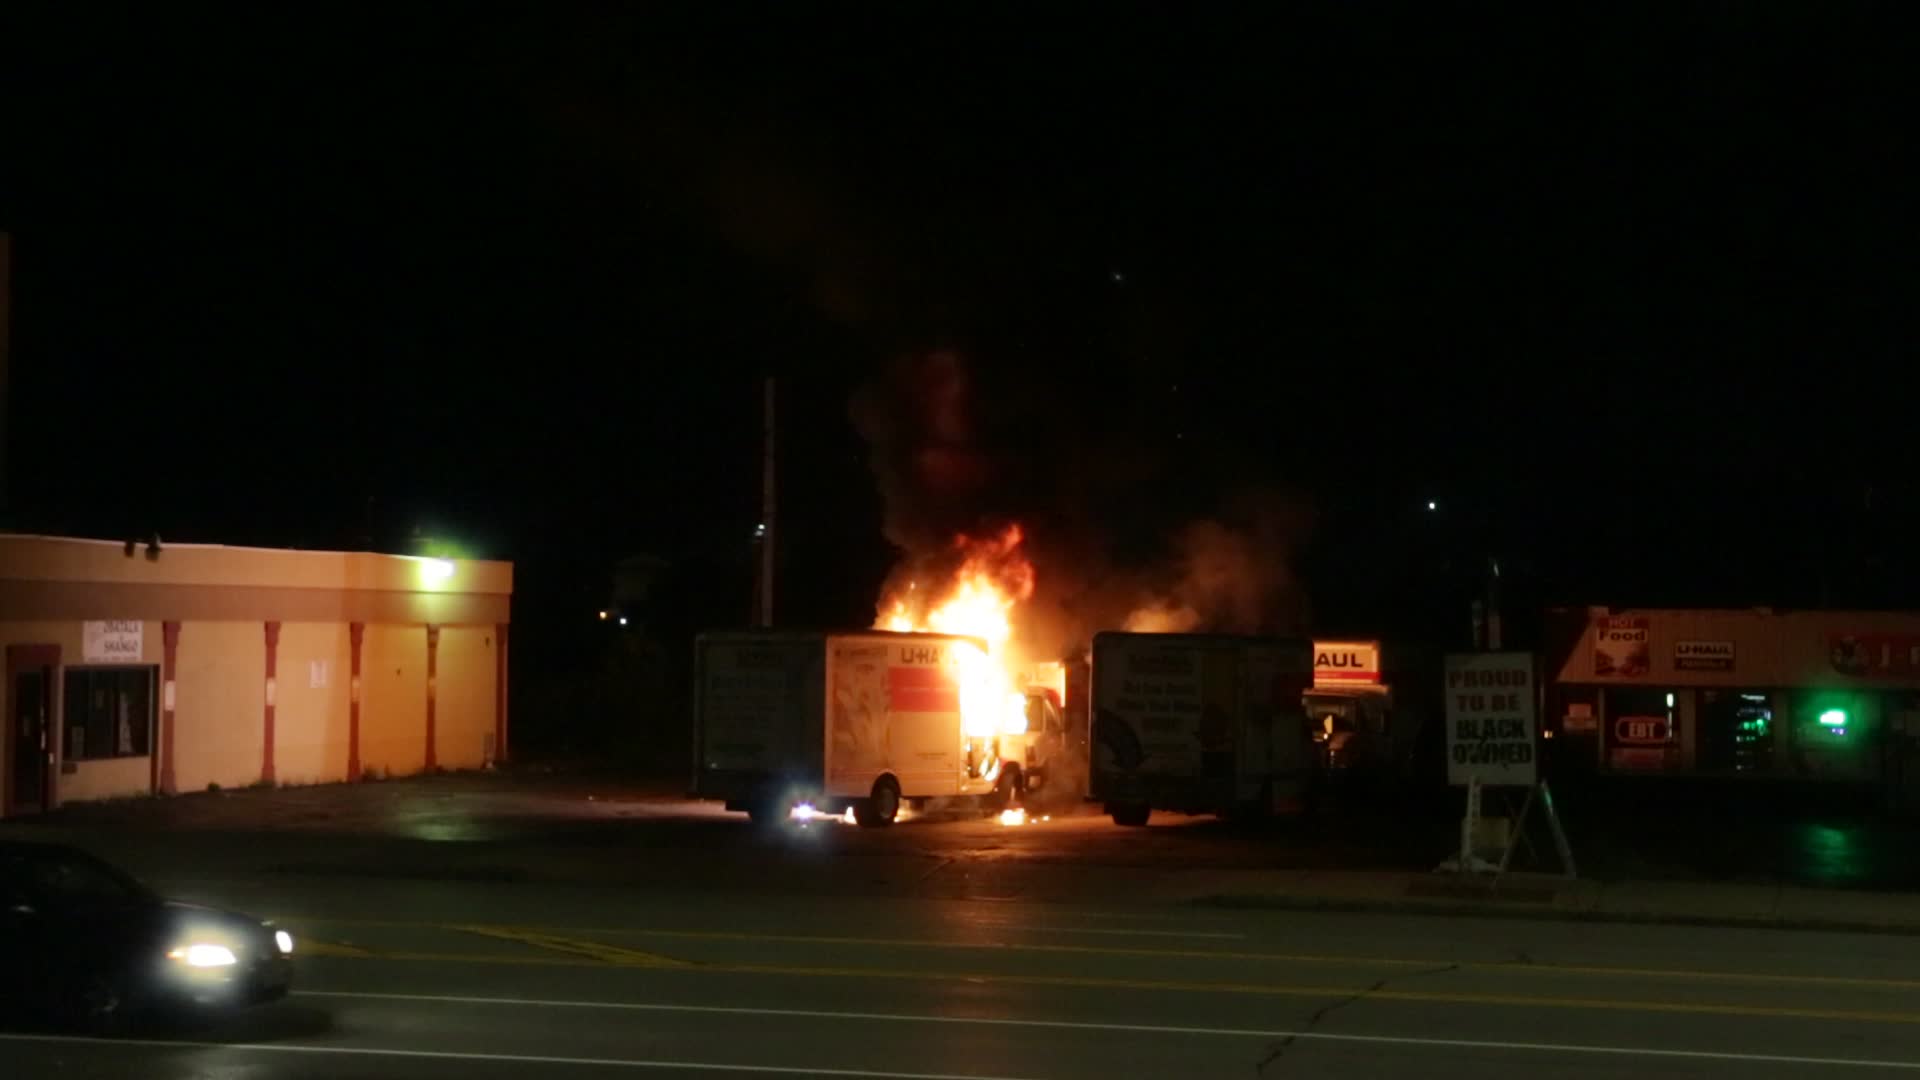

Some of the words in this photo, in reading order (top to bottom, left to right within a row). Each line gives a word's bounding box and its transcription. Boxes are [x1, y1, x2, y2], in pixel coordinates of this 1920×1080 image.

[1599, 631, 1645, 641] Food
[901, 647, 945, 664] U-HA
[1677, 644, 1731, 655] U-HAUL
[1448, 669, 1527, 688] PROUD
[1456, 694, 1485, 712] TO
[1491, 694, 1520, 712] BE
[1456, 719, 1527, 740] BLACK
[1628, 722, 1656, 738] EBT
[1453, 742, 1532, 764] OWNED
